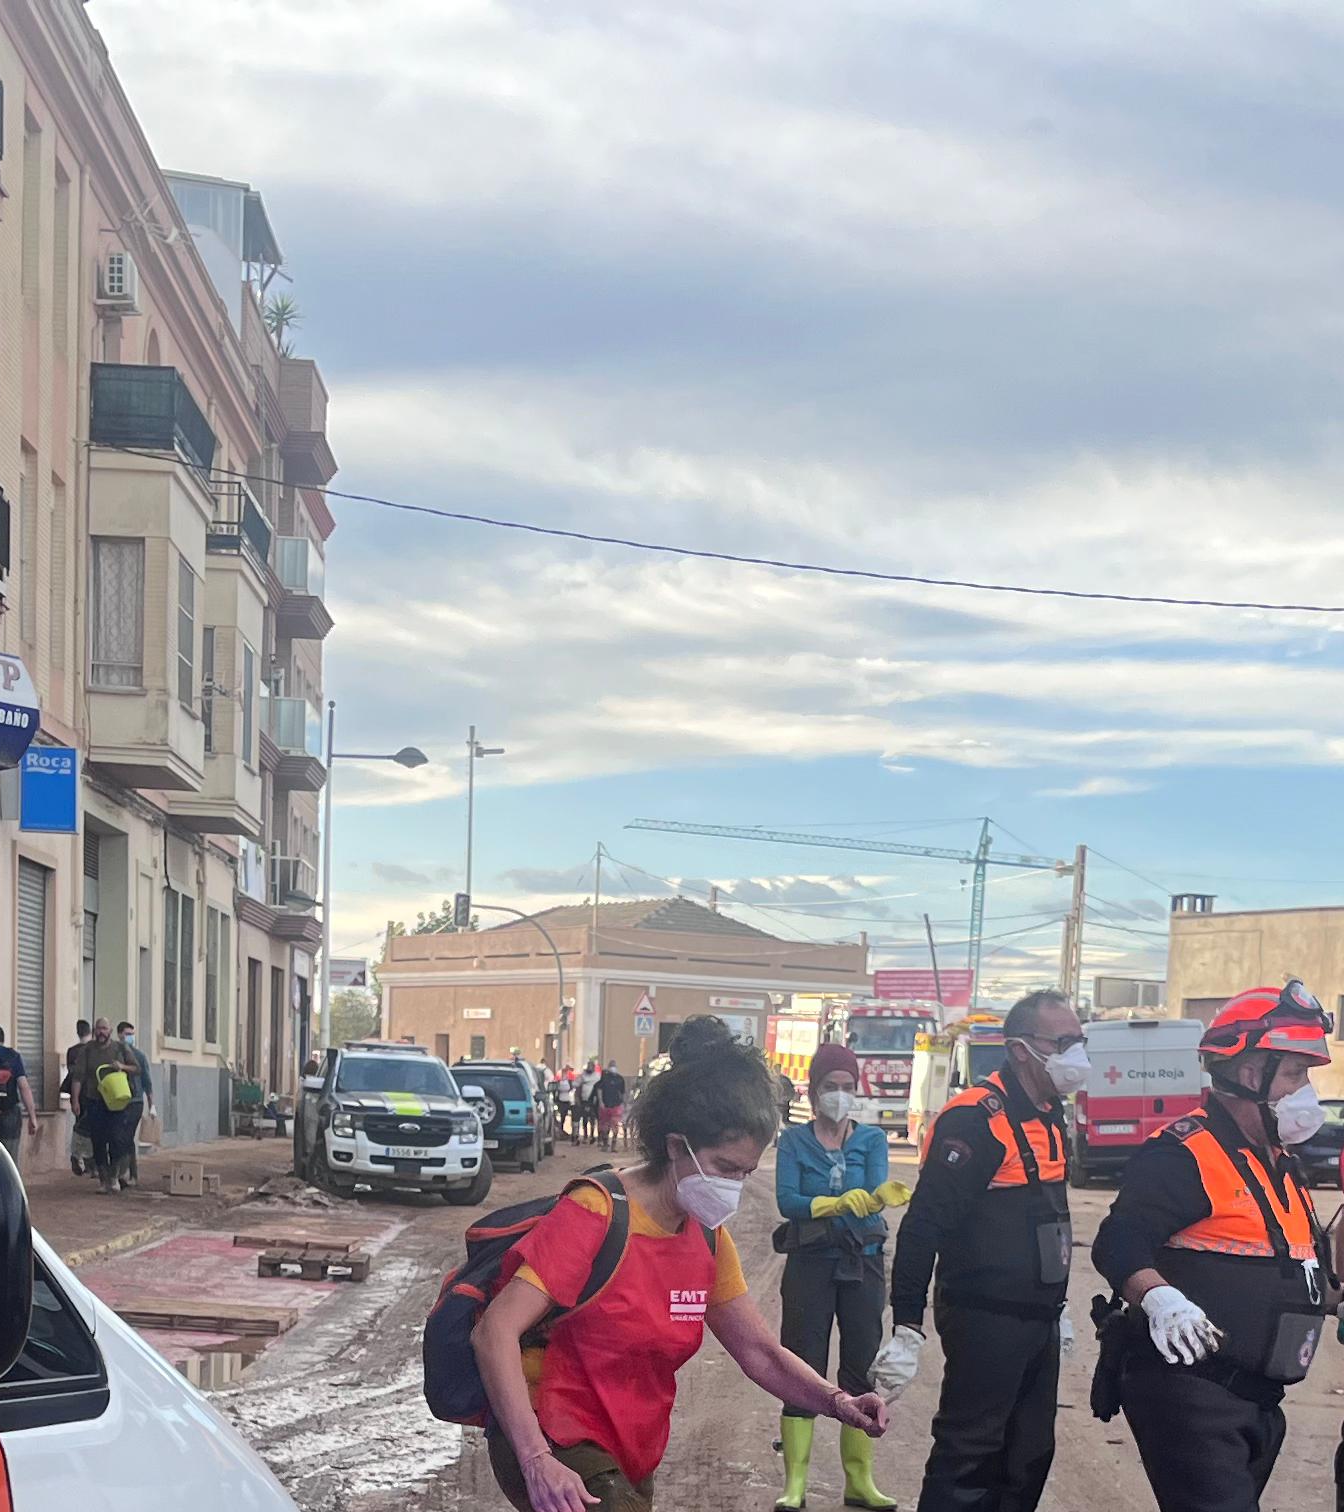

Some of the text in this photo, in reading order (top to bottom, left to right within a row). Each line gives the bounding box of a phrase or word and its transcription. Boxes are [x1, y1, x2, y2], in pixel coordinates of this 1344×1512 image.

[25, 752, 72, 769] Roca
[1127, 1068, 1185, 1079] Creu Roja
[669, 1289, 708, 1303] EMT
